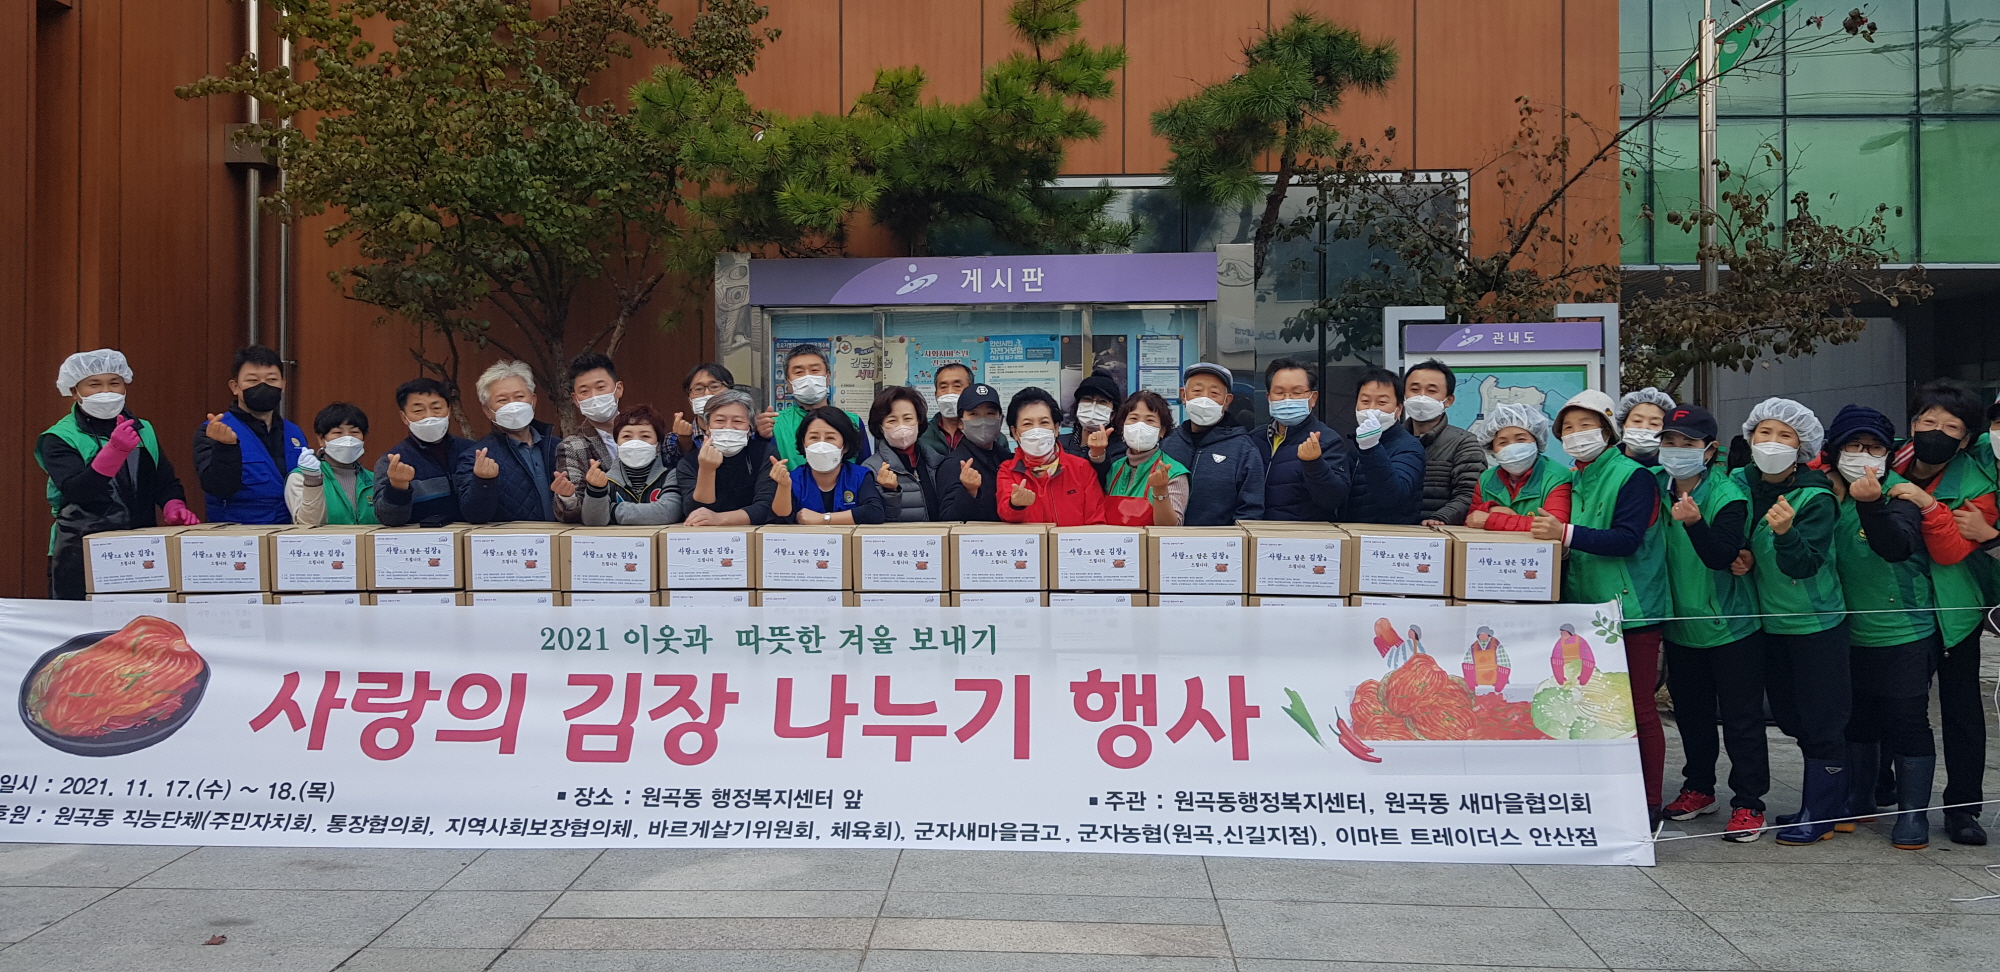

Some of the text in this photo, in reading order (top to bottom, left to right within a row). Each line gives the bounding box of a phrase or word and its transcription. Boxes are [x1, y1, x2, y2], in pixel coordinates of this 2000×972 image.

[961, 267, 1045, 293] 게시판
[1491, 331, 1536, 345] 관내도
[850, 357, 894, 369] 긴급봄
[540, 624, 996, 656] 2021 이웃과 따뜻한 겨울 보내기
[249, 669, 1260, 769] 사랑의 김장 나누기 행사
[0, 774, 38, 795] 일시
[59, 776, 114, 797] 2021.
[126, 778, 153, 798] 11.
[166, 778, 232, 801] 17.(수)
[268, 780, 335, 804] 18.(목)
[573, 786, 614, 808] 장소
[641, 786, 703, 809] 원곡동
[711, 788, 834, 810] 행정복지센터
[843, 789, 864, 810] 앞
[1104, 790, 1147, 812] 주관
[1173, 790, 1375, 816] 원곡동행정복지센터,
[1384, 791, 1450, 815] 원곡동
[1458, 792, 1592, 815] 새마을협의회
[53, 806, 115, 828] 원곡동
[122, 809, 317, 834] 직능단체(주민자치회,
[326, 814, 434, 837] 통장협의회,
[444, 816, 639, 840] 지역사회보장협의체,
[647, 819, 821, 841] 바르게살기위원회,
[830, 820, 906, 842] 체육회),
[913, 821, 1071, 844] 군자새마을금고,
[1077, 823, 1326, 847] 군자농협(원곡,신길지점),
[1335, 826, 1403, 847] 이마트
[1410, 826, 1523, 847] 트레이더스
[1528, 826, 1598, 847] 안산점
